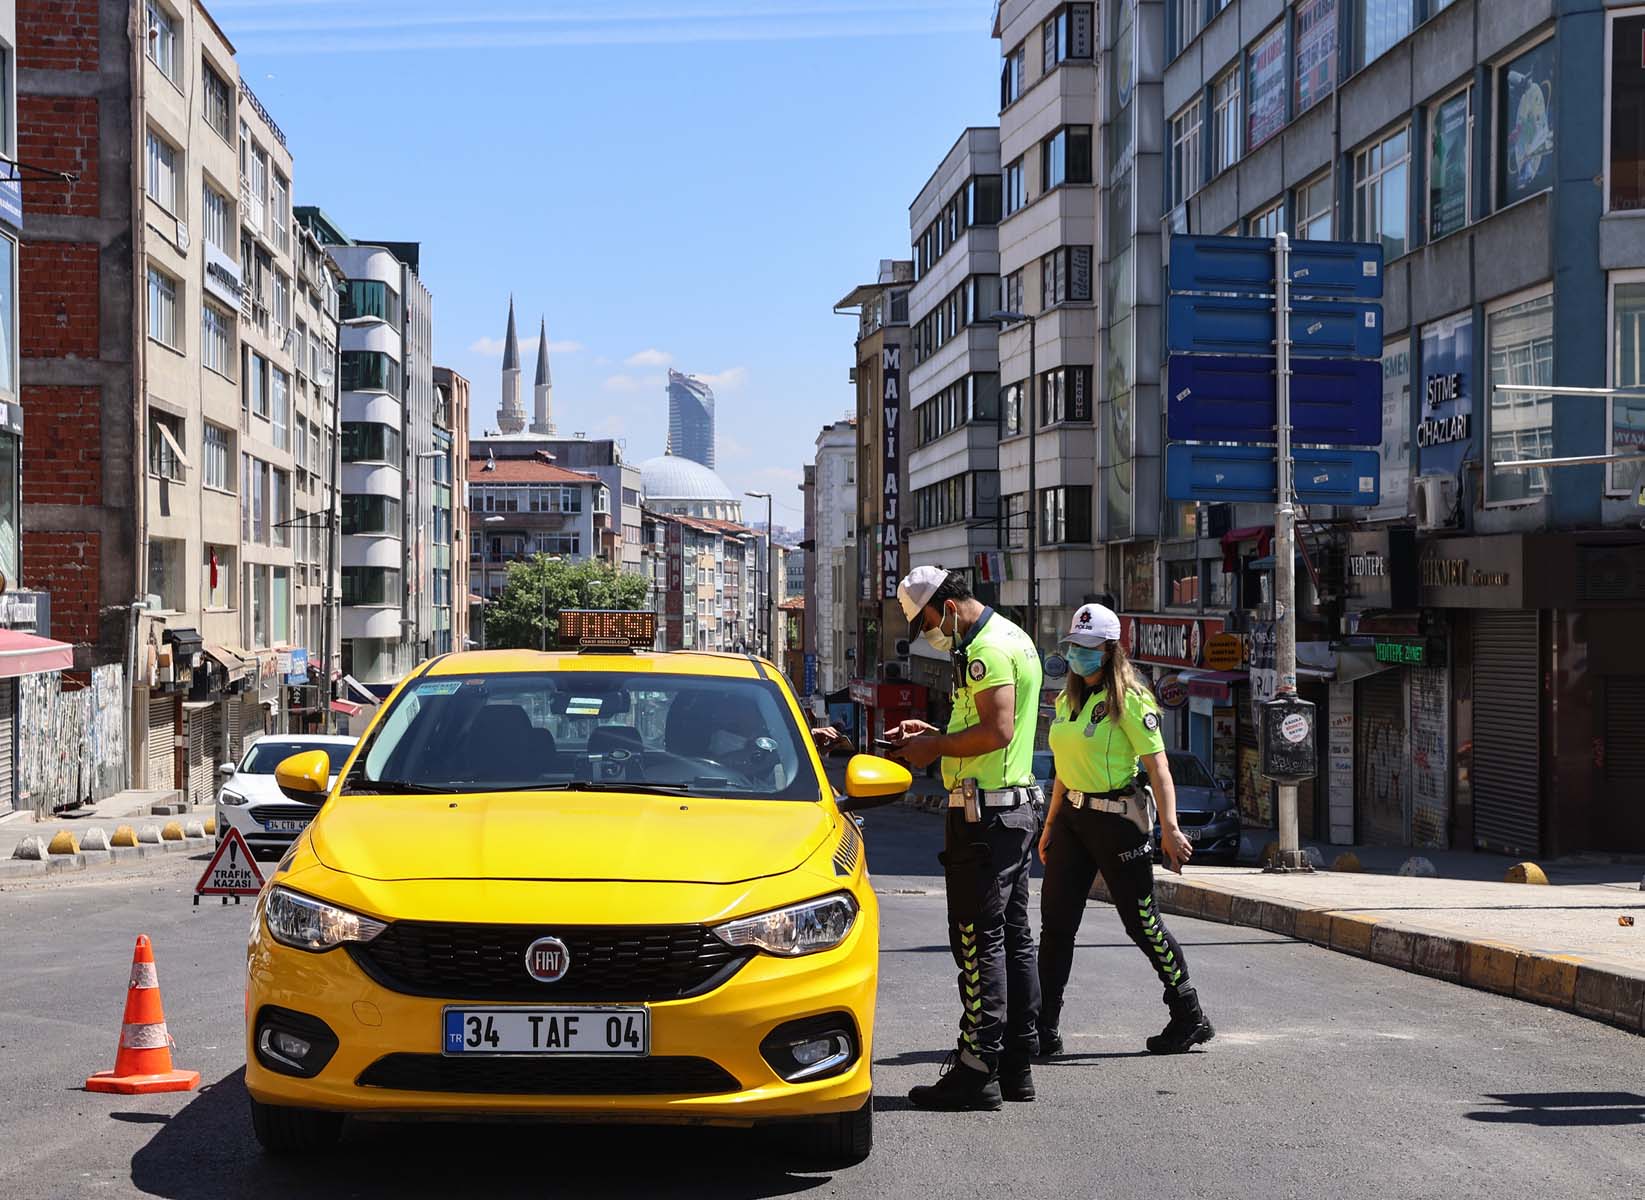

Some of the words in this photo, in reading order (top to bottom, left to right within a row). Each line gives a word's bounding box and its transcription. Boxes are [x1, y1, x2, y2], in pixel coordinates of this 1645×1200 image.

[883, 348, 900, 458] MAVİ
[1425, 373, 1458, 410] İŞİTME
[884, 472, 898, 598] AJANS
[1350, 552, 1385, 576] YEDİTEPE
[1139, 623, 1166, 657] BURGER
[1167, 623, 1187, 660] KING
[213, 879, 251, 889] KAZASI
[214, 868, 251, 879] TRAFİK
[535, 951, 561, 970] FIAT
[450, 1034, 462, 1043] TR
[466, 1016, 500, 1048] 34
[528, 1016, 579, 1048] TAF
[606, 1016, 640, 1048] 04
